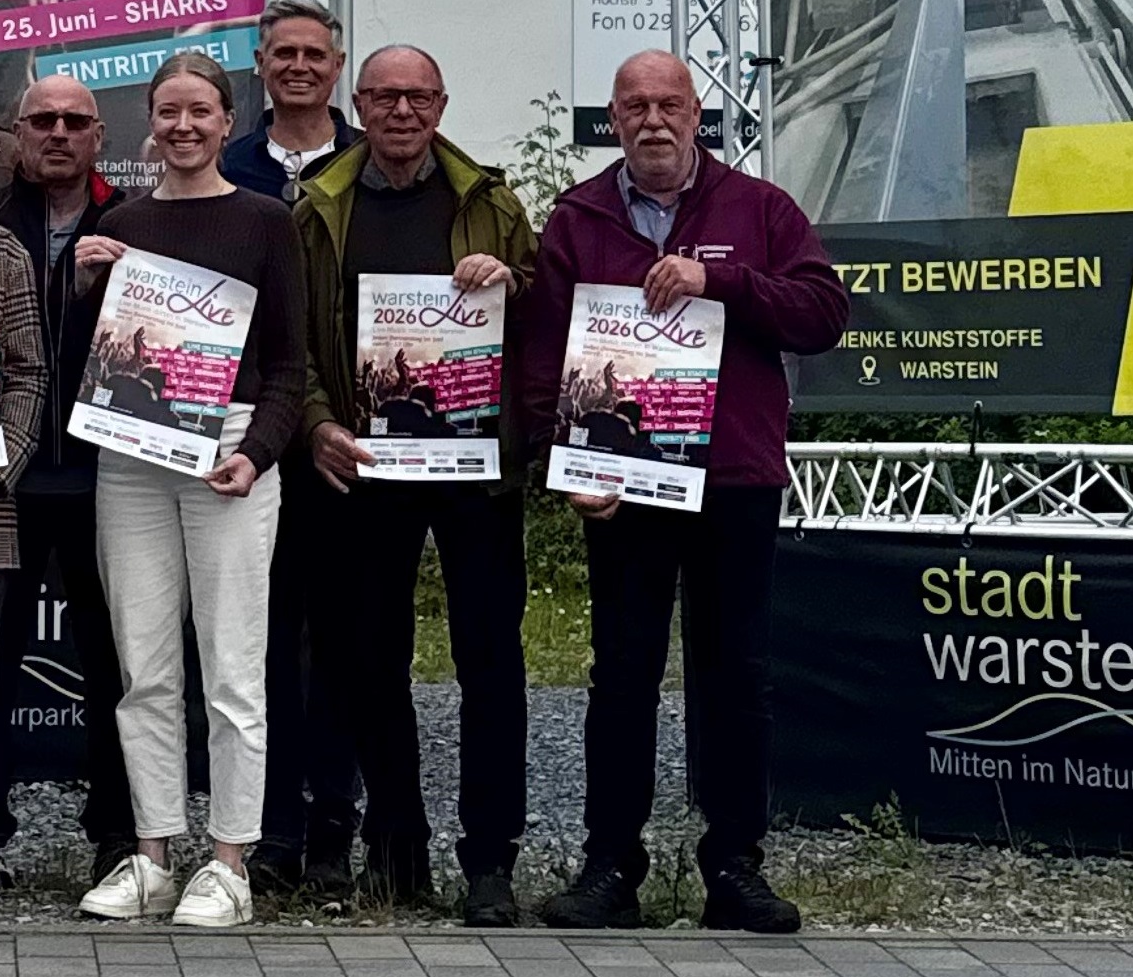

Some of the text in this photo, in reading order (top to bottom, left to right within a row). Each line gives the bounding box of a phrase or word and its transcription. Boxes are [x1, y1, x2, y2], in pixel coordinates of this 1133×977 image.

[2, 18, 42, 42] 25.
[48, 7, 97, 40] Juni
[591, 11, 626, 30] Fon
[104, 173, 158, 187] arstein
[125, 265, 202, 297] warstein
[901, 256, 1102, 292] BEWERBEN
[121, 282, 165, 306] 2026
[372, 290, 450, 307] warstein
[373, 308, 417, 324] 2026
[586, 316, 631, 337] 2026
[901, 329, 1044, 348] KUNSTSTOFFE
[900, 361, 998, 379] WARSTEIN
[921, 554, 1082, 622] stadt
[923, 628, 1133, 692] warste
[929, 747, 1133, 790] Mitten im Natu
